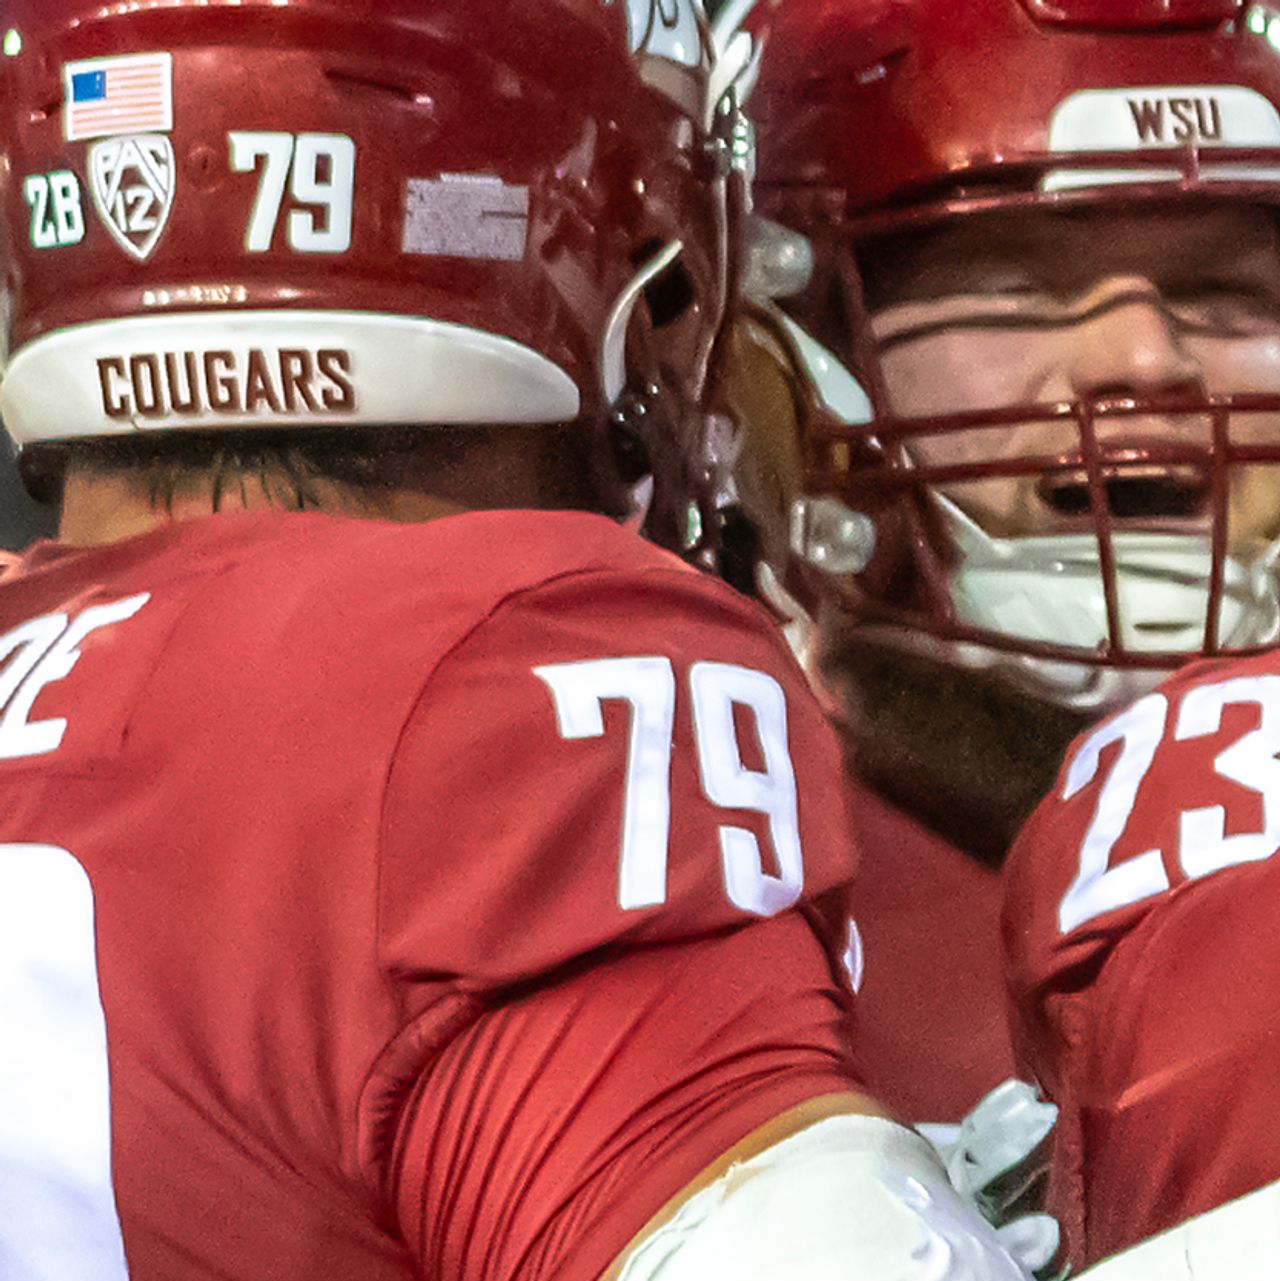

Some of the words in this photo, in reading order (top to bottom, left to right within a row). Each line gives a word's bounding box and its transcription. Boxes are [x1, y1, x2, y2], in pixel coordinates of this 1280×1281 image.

[1127, 98, 1223, 142] WSU
[115, 185, 158, 233] 12
[228, 131, 356, 254] 79
[97, 349, 355, 418] COUGARS
[533, 655, 805, 917] 79
